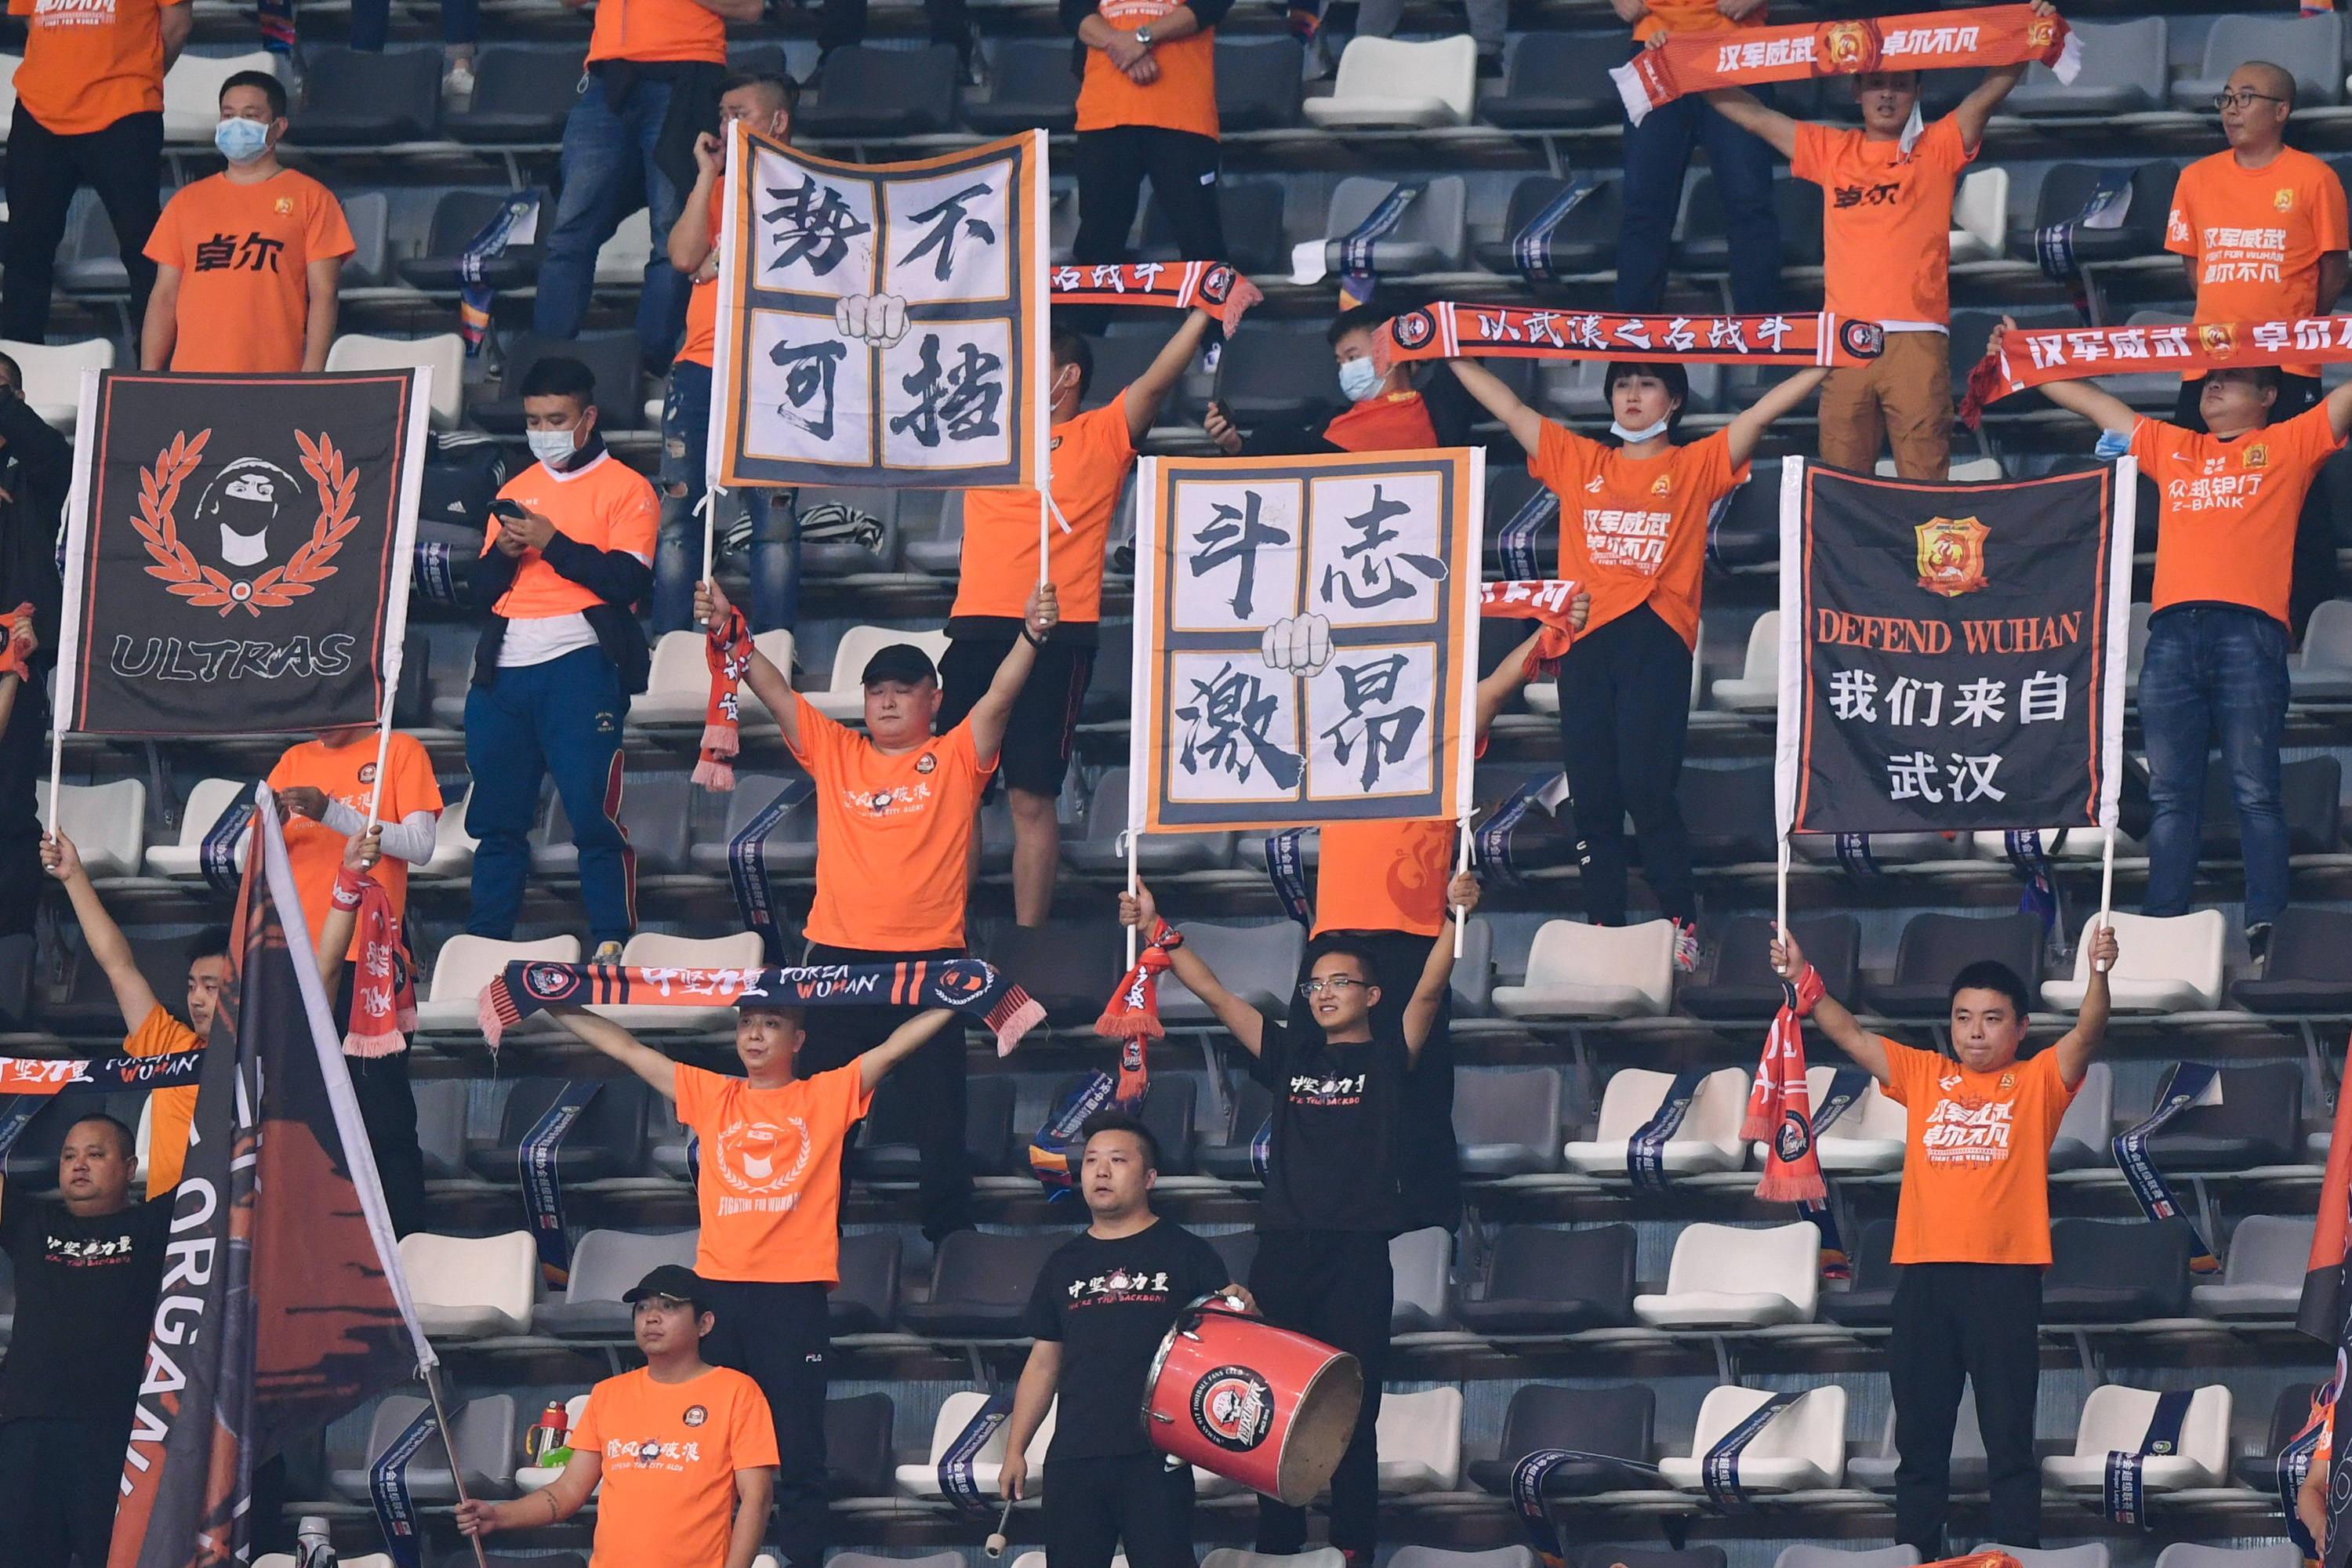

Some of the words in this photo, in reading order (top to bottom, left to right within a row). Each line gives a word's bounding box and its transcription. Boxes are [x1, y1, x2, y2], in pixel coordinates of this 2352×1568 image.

[1716, 36, 1817, 72] 汉军威武
[1881, 26, 1980, 56] 卓尔不凡
[194, 231, 284, 273] 卓尔
[2224, 249, 2244, 260] FOR
[2026, 327, 2193, 369] 汉军威武
[1190, 485, 1448, 620] 斗志
[1817, 608, 1952, 654] DEFEND
[1961, 611, 2082, 654] WUHAN
[111, 633, 356, 682] ULTRAS
[1828, 670, 2070, 728] 我们来自
[1176, 652, 1425, 792] 激昂
[1886, 750, 2007, 803] 武汉
[779, 964, 849, 985] FORZA
[797, 974, 880, 1000] WUHAN
[121, 1054, 199, 1083] WUHAN
[1068, 1272, 1169, 1298] 中坚力量
[1207, 1369, 1225, 1382] FANS
